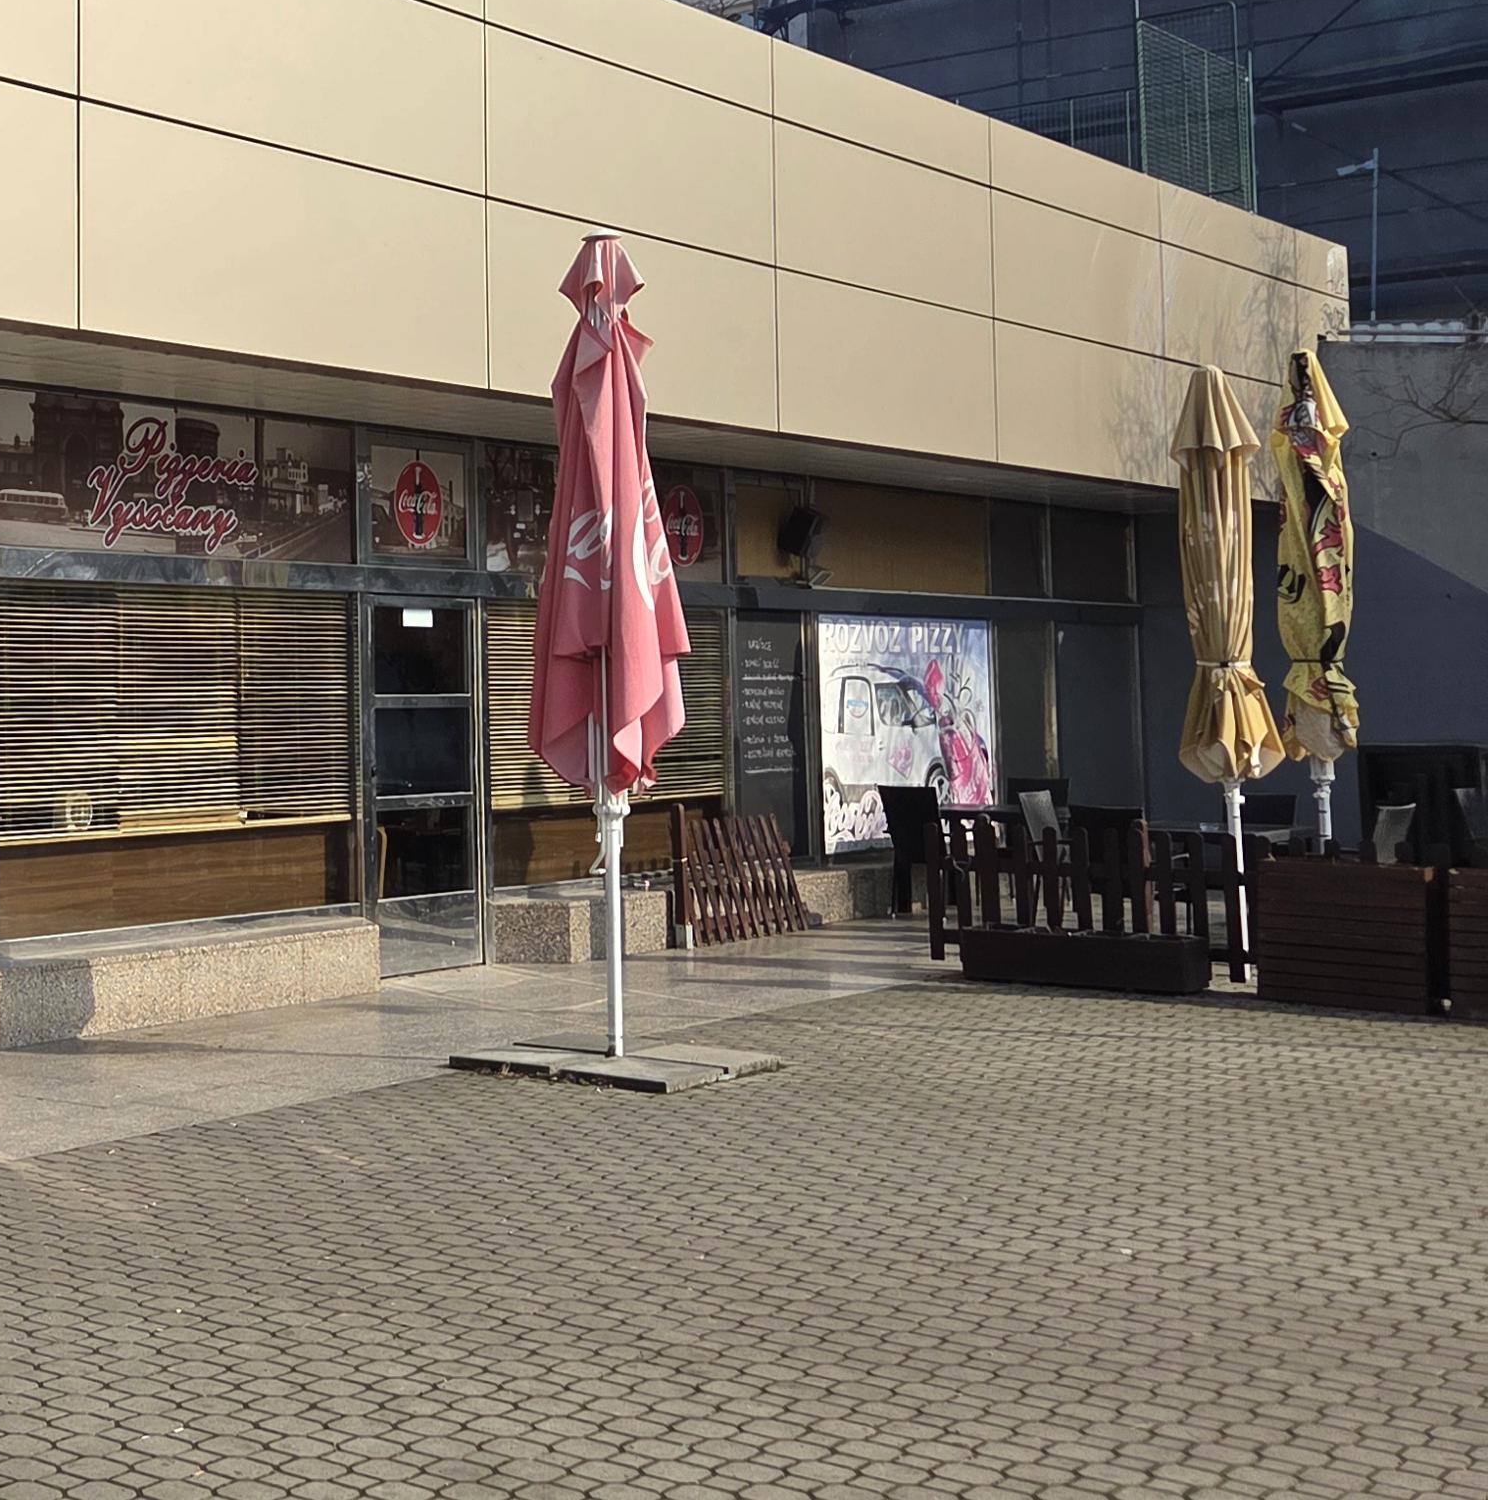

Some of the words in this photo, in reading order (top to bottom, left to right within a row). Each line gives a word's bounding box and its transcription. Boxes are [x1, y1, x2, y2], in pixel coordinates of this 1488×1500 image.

[116, 417, 260, 500] Pizzeria
[821, 618, 902, 653] ROZVOZ
[911, 622, 964, 654] PIZZY
